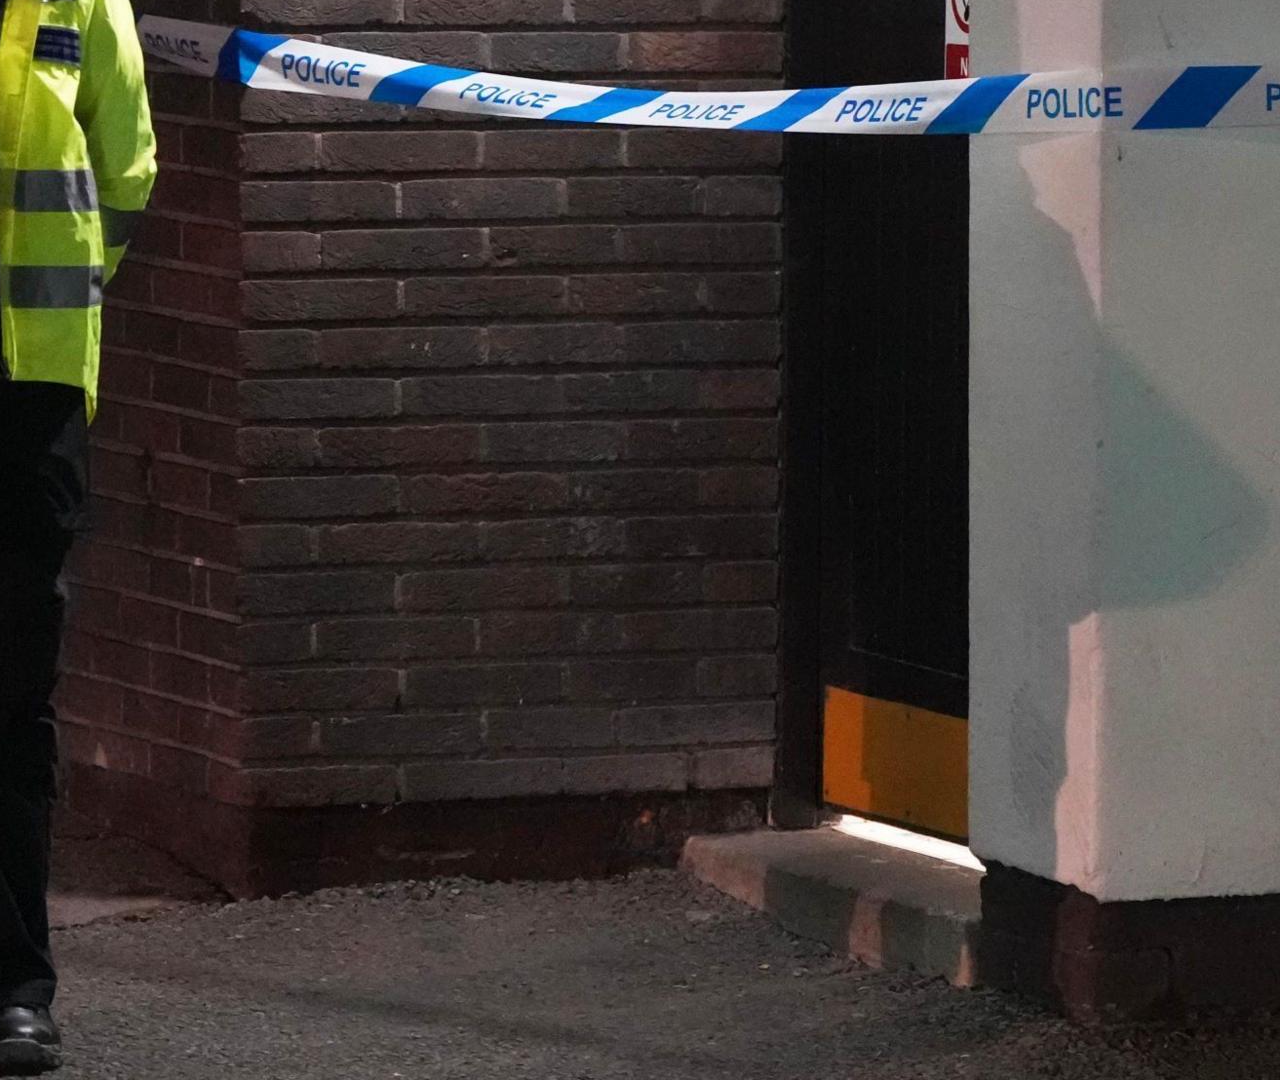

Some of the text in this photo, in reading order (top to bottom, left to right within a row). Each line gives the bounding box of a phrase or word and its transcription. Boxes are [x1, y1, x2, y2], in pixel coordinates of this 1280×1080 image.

[280, 53, 367, 88] POLICE
[458, 82, 557, 109] POLICE
[649, 103, 746, 122] POLICE
[834, 97, 927, 123] POLICE
[1026, 87, 1122, 119] POLICE
